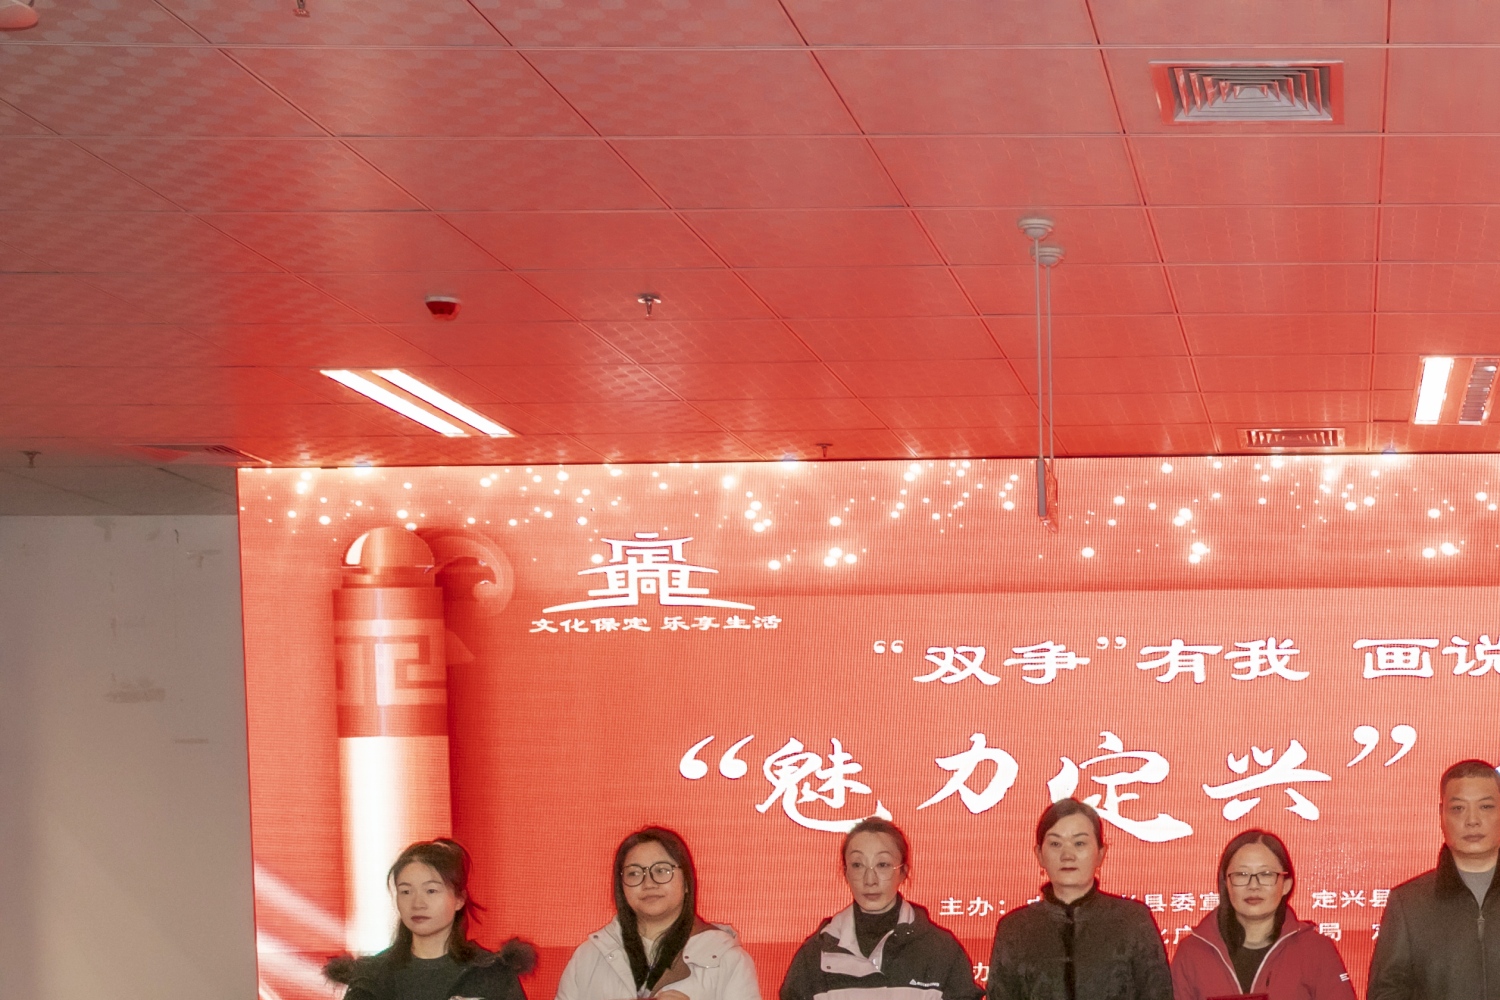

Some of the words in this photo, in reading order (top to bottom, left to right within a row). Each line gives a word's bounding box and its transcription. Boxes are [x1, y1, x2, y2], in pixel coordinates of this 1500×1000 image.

[528, 616, 652, 633] 文化保定
[660, 615, 783, 631] 乐享生活
